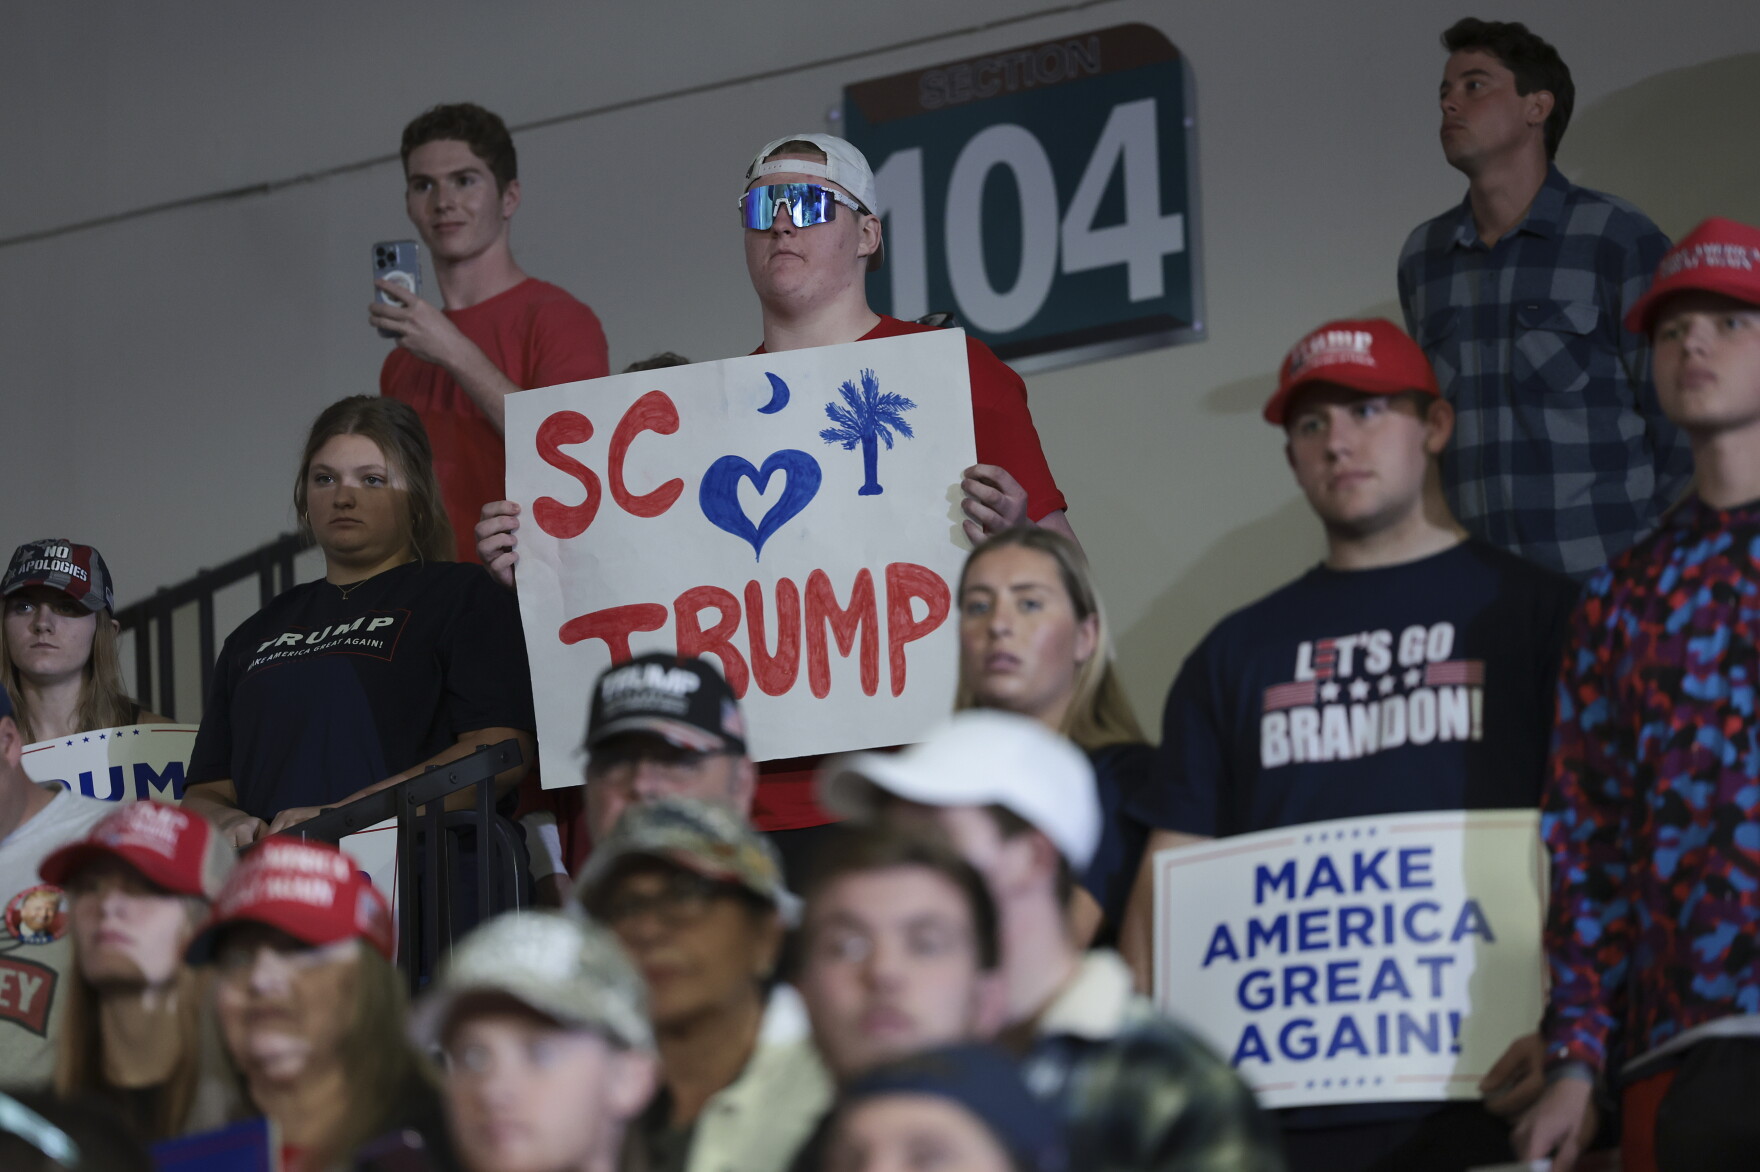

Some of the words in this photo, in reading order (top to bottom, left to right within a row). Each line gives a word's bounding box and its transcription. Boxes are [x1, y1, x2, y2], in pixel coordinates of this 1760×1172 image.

[918, 35, 1101, 110] SECTION
[874, 97, 1185, 334] 104
[533, 389, 685, 540] SC
[18, 558, 88, 583] APOLOGIES
[44, 545, 70, 559] NO
[256, 616, 395, 653] TRUMP
[268, 648, 311, 661] AMERICA
[313, 638, 343, 652] GREAT
[344, 637, 384, 648] AGAIN!
[559, 562, 952, 701] TRUMP
[1295, 629, 1393, 683] LET'S
[1398, 621, 1455, 668] GO
[1260, 685, 1484, 770] BRANDON!
[1253, 846, 1435, 907] MAKE
[1202, 897, 1496, 969] AMERICA
[1236, 953, 1456, 1013] GREAT
[1231, 1011, 1463, 1069] AGAIN!
